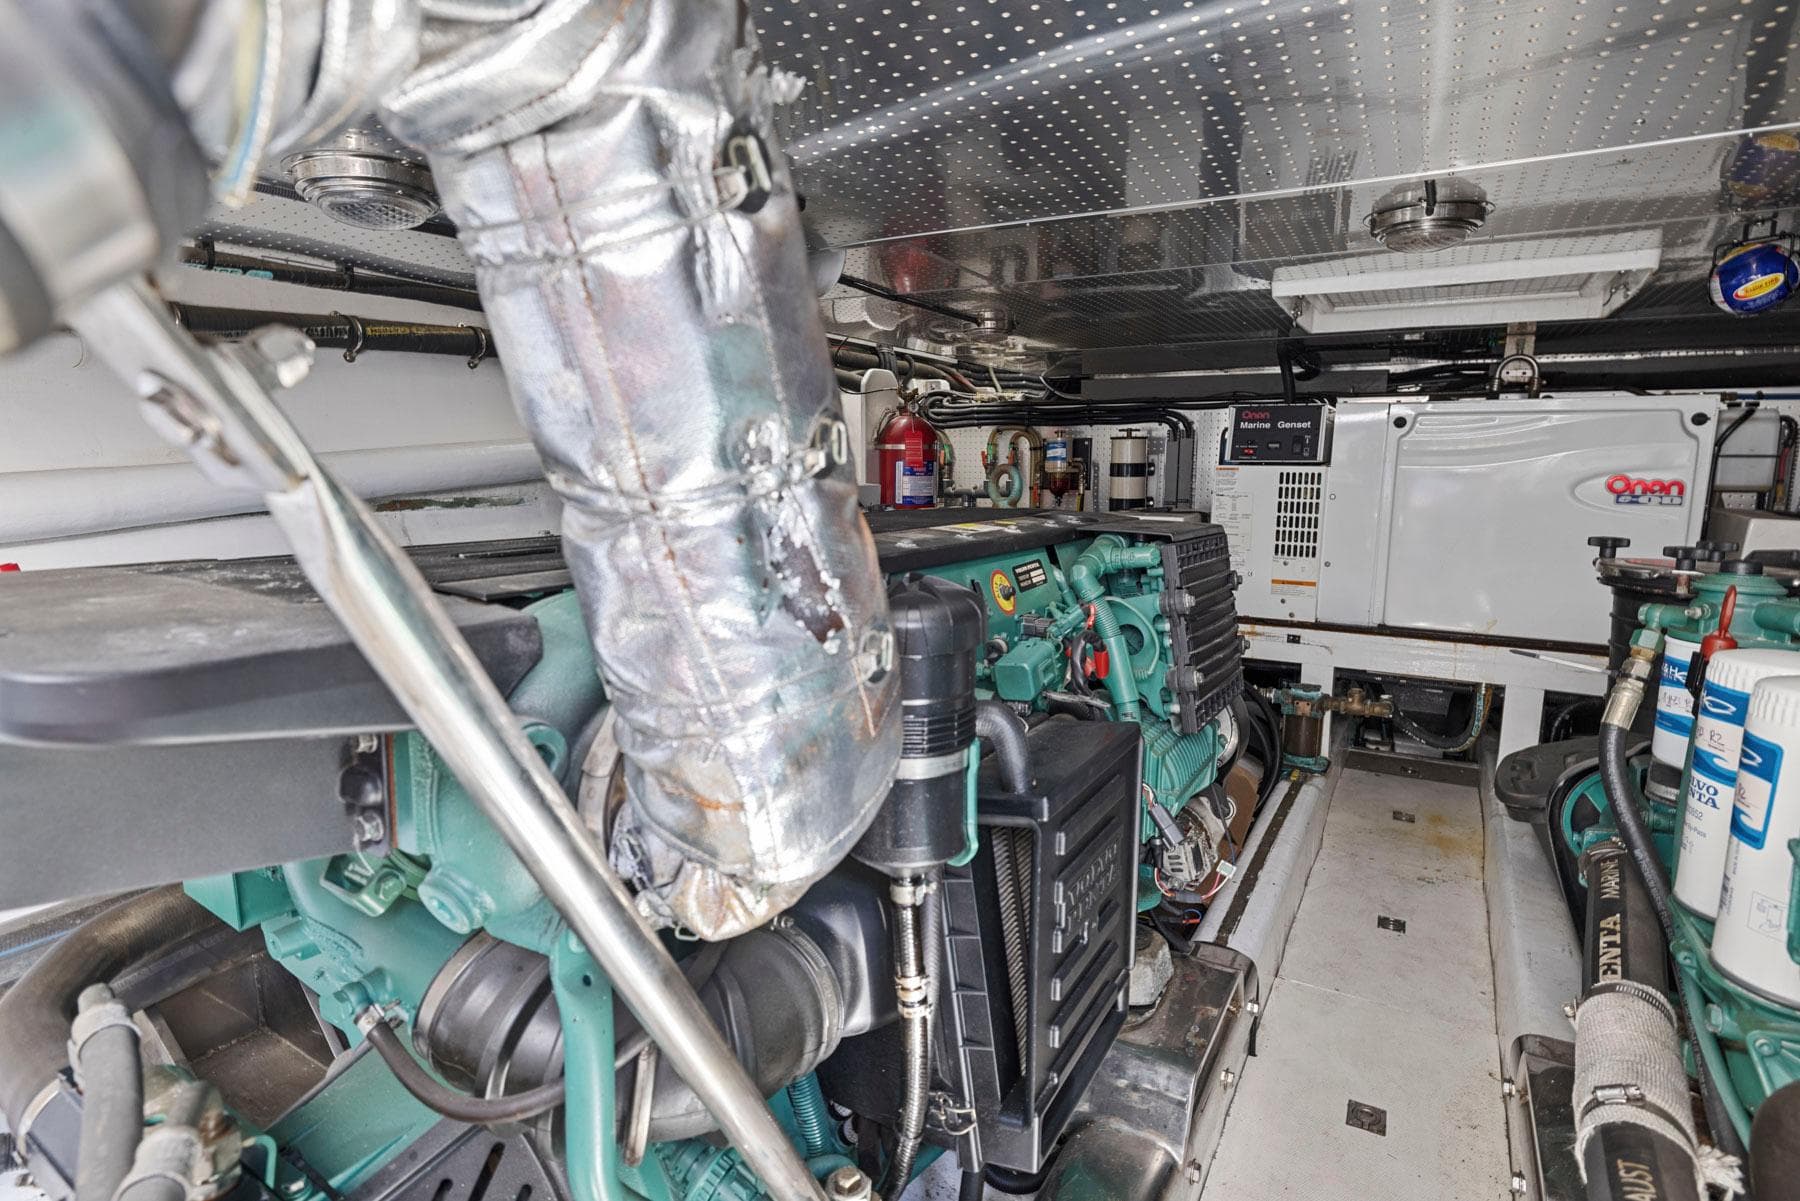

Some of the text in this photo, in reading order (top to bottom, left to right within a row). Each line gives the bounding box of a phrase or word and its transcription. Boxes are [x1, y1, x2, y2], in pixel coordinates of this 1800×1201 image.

[1240, 421, 1311, 429] Marine Genset
[1241, 410, 1270, 419] Onan
[1606, 474, 1684, 496] Onan
[1691, 776, 1719, 796] LVO
[1688, 786, 1720, 810] NTA
[1600, 858, 1620, 899] MARINE
[1599, 913, 1622, 982] ENTA
